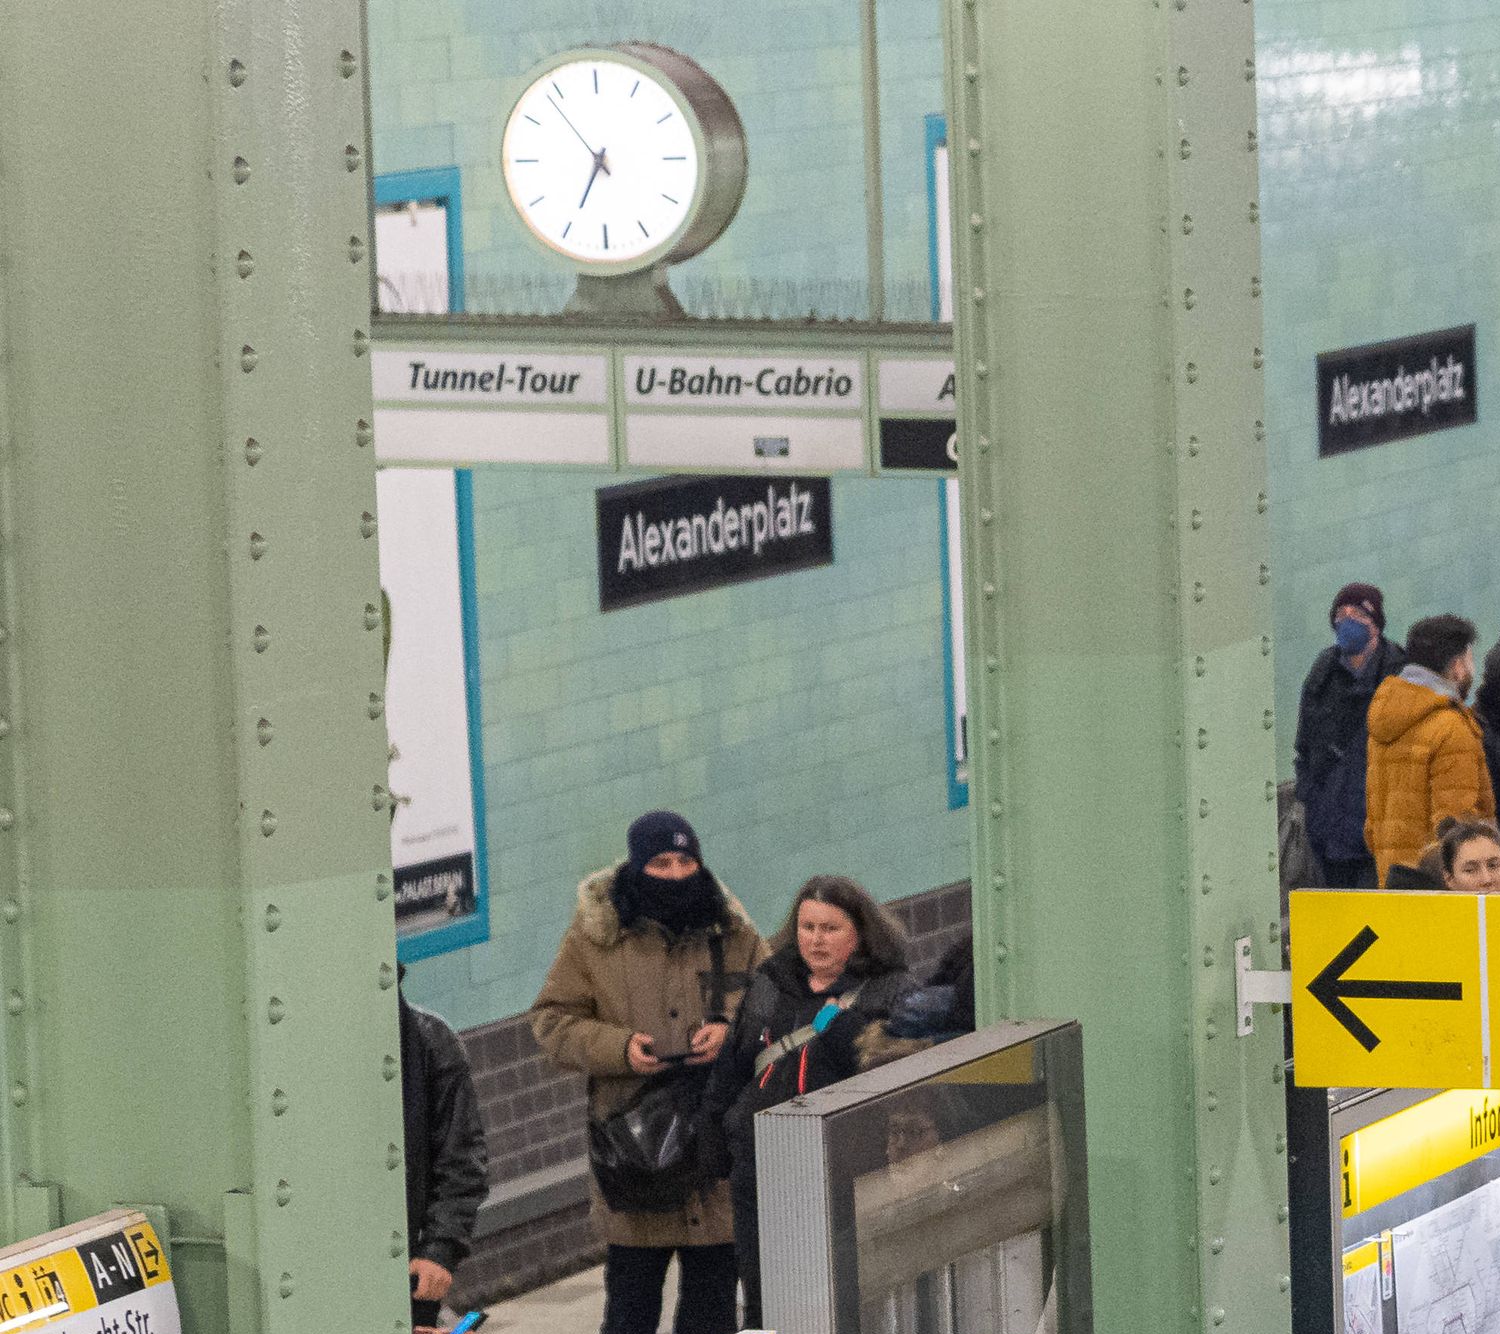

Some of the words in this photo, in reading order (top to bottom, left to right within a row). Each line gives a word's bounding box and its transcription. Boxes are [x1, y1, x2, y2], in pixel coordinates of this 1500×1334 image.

[407, 361, 581, 396] Tunnel-Tour
[635, 366, 854, 399] U-Bahn-Cabrio
[1329, 353, 1465, 427] Alexanderplatz
[617, 481, 816, 575] Alexanderplatz
[90, 1241, 137, 1291] A-N
